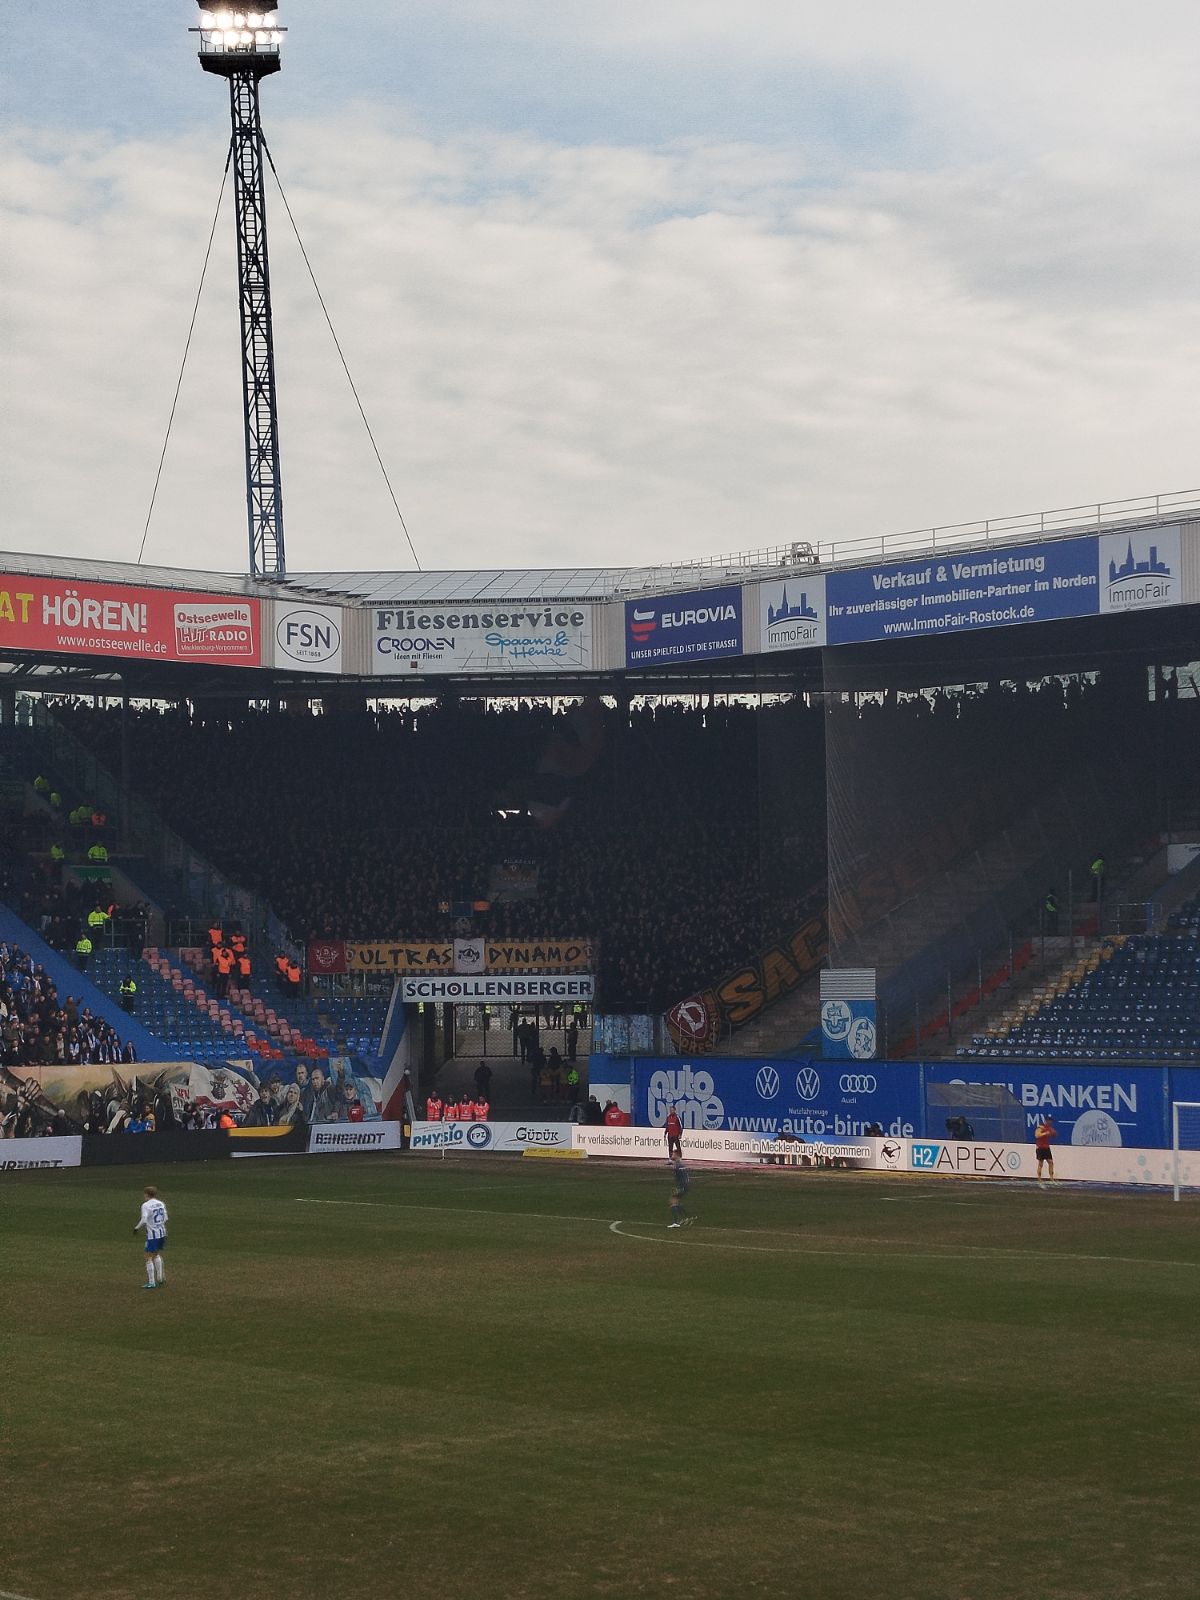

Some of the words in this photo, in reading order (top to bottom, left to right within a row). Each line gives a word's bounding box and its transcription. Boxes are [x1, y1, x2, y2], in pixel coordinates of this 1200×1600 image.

[872, 568, 932, 590] Verkauf
[936, 566, 948, 582] &
[951, 556, 1045, 579] Vermietung
[829, 605, 843, 617] Ihr
[846, 597, 918, 615] zuverlässiger
[921, 583, 1031, 606] Immobilien-Partner
[1034, 580, 1049, 592] im
[1053, 575, 1096, 589] Norden
[1109, 582, 1171, 603] ImmoFair
[42, 589, 147, 633] HÖREN!
[177, 610, 248, 623] Ostseewelle
[377, 608, 585, 630] Fliesenservice
[661, 605, 736, 628] EUROVIA
[883, 605, 1035, 634] www.ImmoFair-Rostock.de
[57, 634, 168, 653] www.ostseewelle.de
[287, 622, 331, 649] FSN
[485, 632, 552, 655] Spaans
[554, 631, 570, 646] &
[768, 625, 818, 643] ImmoFair
[377, 636, 455, 654] CROONEN
[631, 649, 652, 659] UNSER
[653, 644, 685, 657] SPIELFELD
[686, 643, 695, 652] IST
[696, 641, 707, 651] DIE
[359, 946, 453, 967] ULTRAS
[488, 945, 581, 966] DYNAMO
[405, 981, 592, 997] SCHOLLENBERGER
[650, 1065, 714, 1101] auto
[413, 1129, 464, 1147] PHYSIO
[516, 1127, 559, 1141] GÜDÜK
[577, 1134, 587, 1144] Ihr
[588, 1134, 632, 1145] verlässlicher
[634, 1136, 662, 1147] Partner
[724, 1139, 750, 1150] Bauen
[761, 1140, 871, 1157] Mecklenburg-Vorpommern
